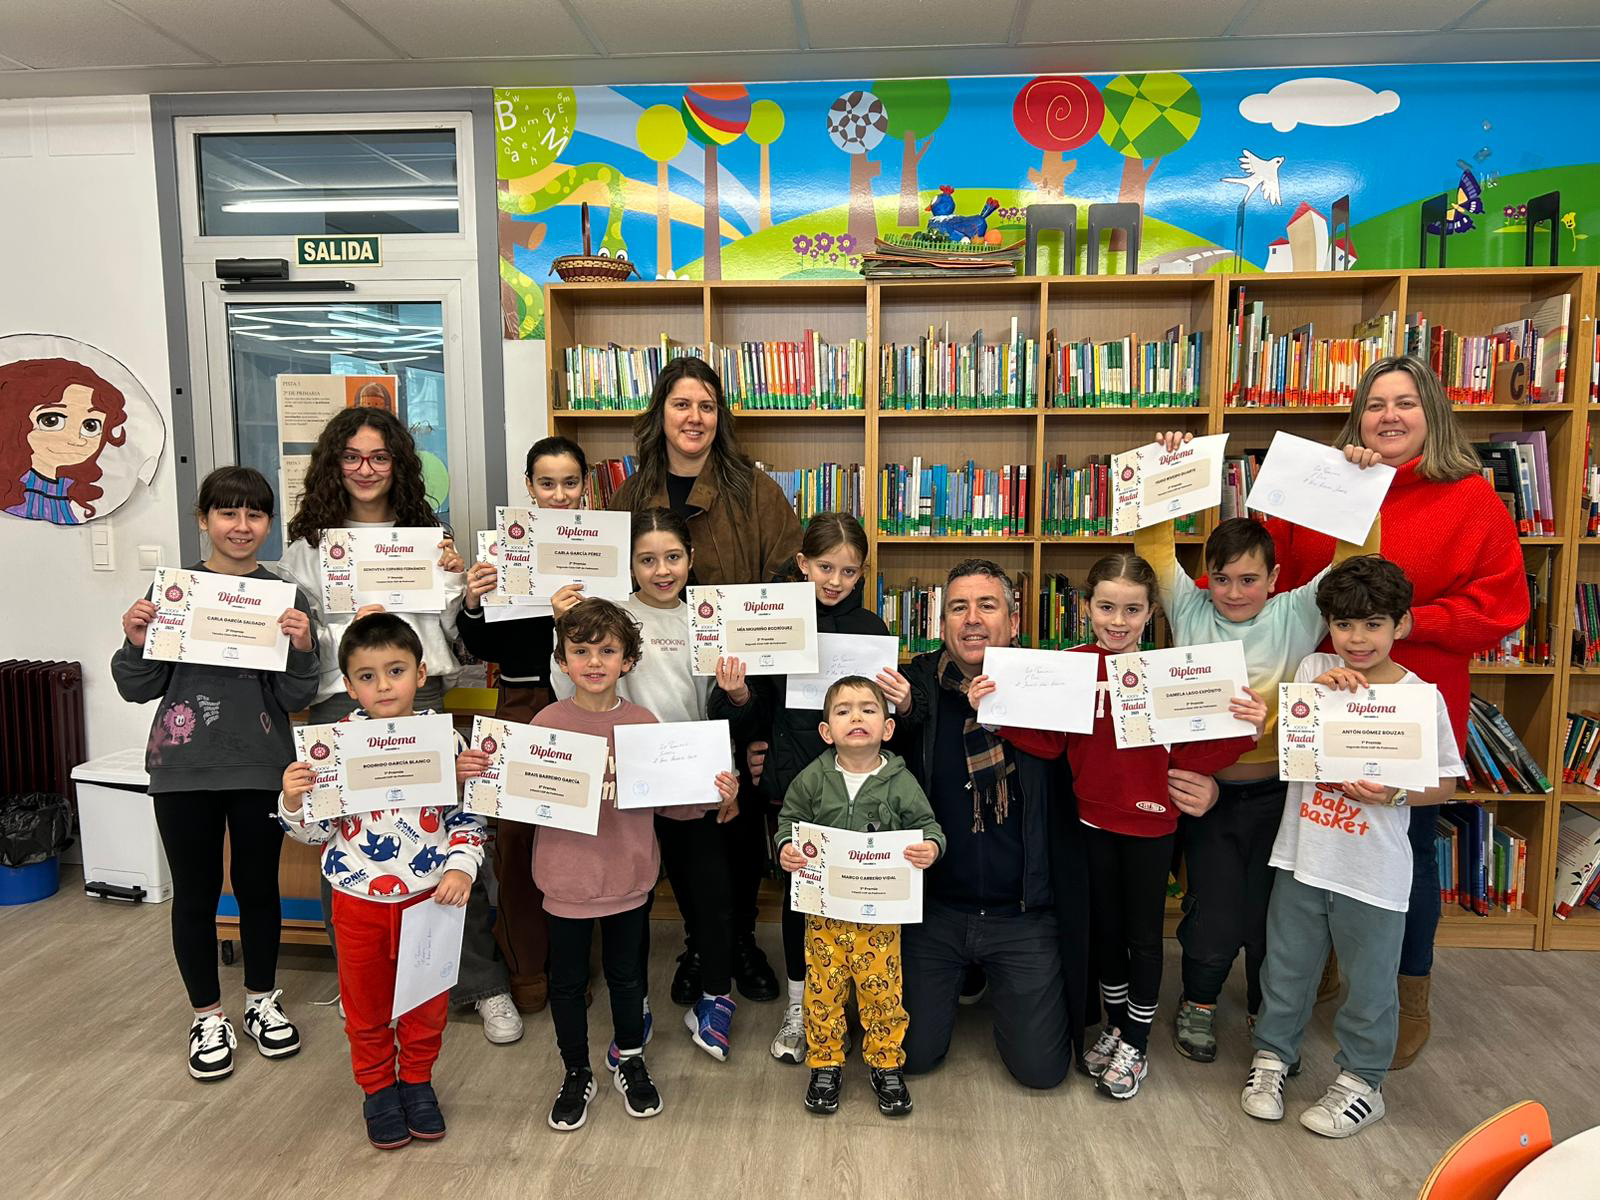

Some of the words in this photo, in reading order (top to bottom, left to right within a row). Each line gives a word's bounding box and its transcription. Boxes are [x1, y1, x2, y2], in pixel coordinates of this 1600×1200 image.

[495, 100, 517, 131] B
[540, 127, 568, 157] M
[511, 151, 519, 162] a
[304, 241, 374, 261] SALIDA
[1510, 362, 1525, 400] C
[1159, 449, 1194, 465] Diploma
[1119, 492, 1138, 503] Nadal
[556, 526, 599, 538] Diploma
[375, 544, 414, 555] Diploma
[505, 553, 530, 562] Nadal
[328, 573, 350, 581] Nadal
[218, 591, 261, 605] Diploma
[744, 601, 784, 614] Diploma
[157, 615, 185, 626] Nadal
[1169, 665, 1211, 679] Diploma
[1121, 702, 1146, 711] Nadal
[1346, 702, 1396, 716] Diploma
[367, 736, 416, 749] Diploma
[1286, 733, 1315, 743] Nadal
[530, 744, 573, 761] Diploma
[1313, 791, 1361, 820] Baby
[1300, 803, 1369, 836] Basket
[398, 817, 420, 840] SONIC
[848, 850, 891, 863] Diploma
[339, 869, 366, 887] SONIC
[799, 869, 821, 882] Nadal
